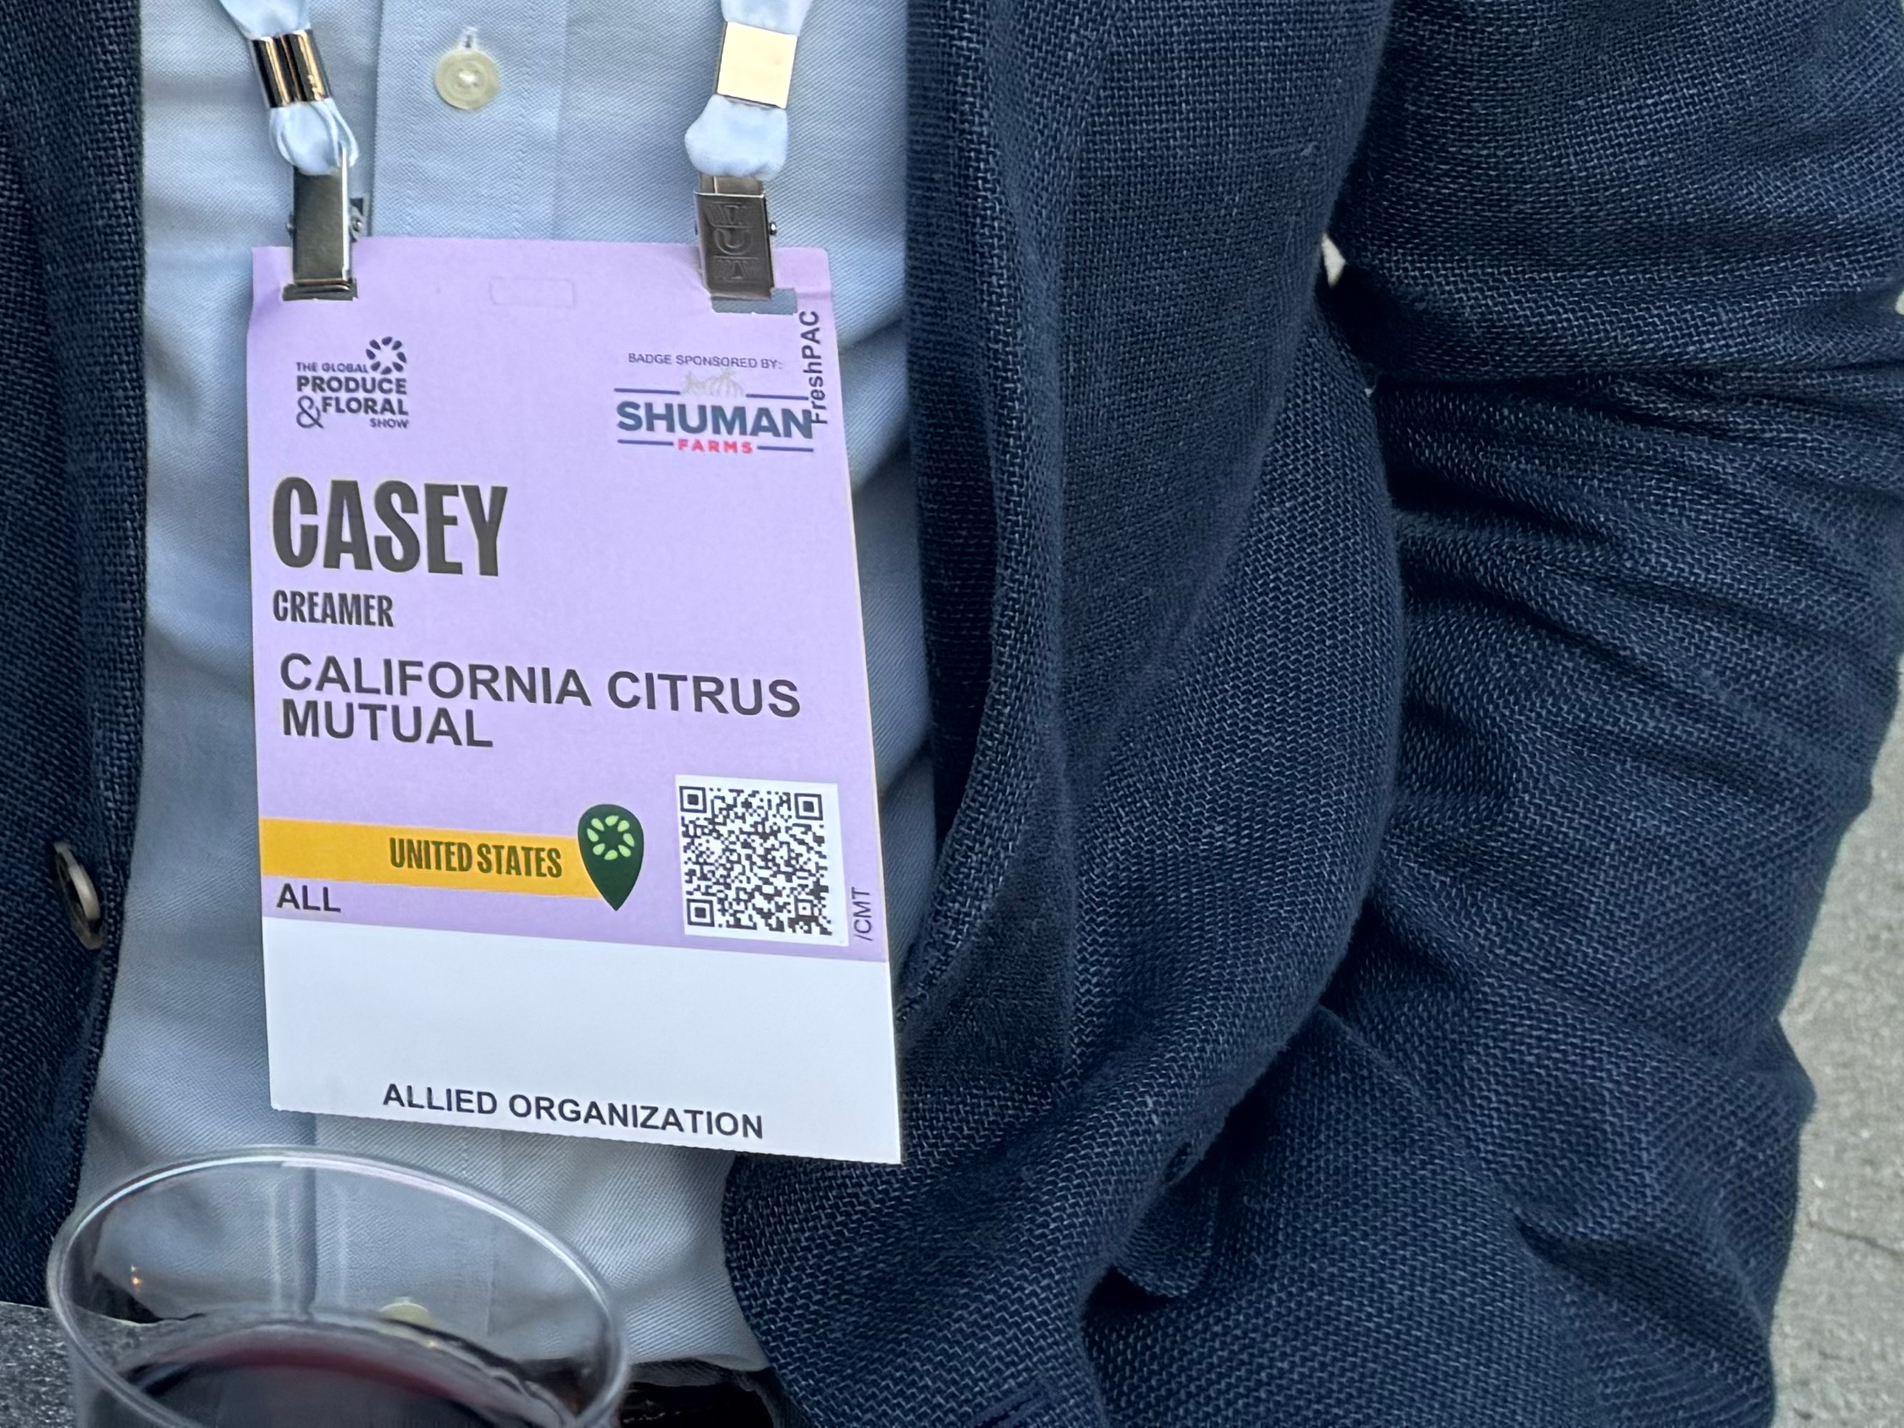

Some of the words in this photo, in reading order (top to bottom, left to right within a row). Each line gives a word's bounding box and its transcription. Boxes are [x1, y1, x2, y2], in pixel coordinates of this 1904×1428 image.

[296, 361, 318, 373] THE
[321, 362, 369, 374] GLOBAL
[628, 352, 672, 365] BADGE
[675, 355, 758, 368] SPONSORED
[799, 310, 828, 424] FreshPAC
[296, 375, 408, 395] PRODUCE
[296, 395, 324, 429] &
[321, 396, 409, 416] FLORAL
[369, 417, 409, 429] SHOW
[616, 400, 814, 439] SHUMAN
[678, 438, 754, 454] FARMS
[271, 475, 509, 578] CASEY
[272, 589, 395, 628] CREAMER
[279, 652, 591, 708] CALIFORNIA
[607, 669, 802, 718] CITRUS
[281, 697, 493, 749] MUTUAL
[389, 836, 473, 872] UNITED
[476, 845, 563, 879] STATES
[275, 883, 342, 914] ALL
[382, 1082, 498, 1115] ALLIED
[508, 1093, 764, 1140] ORGANIZATION
